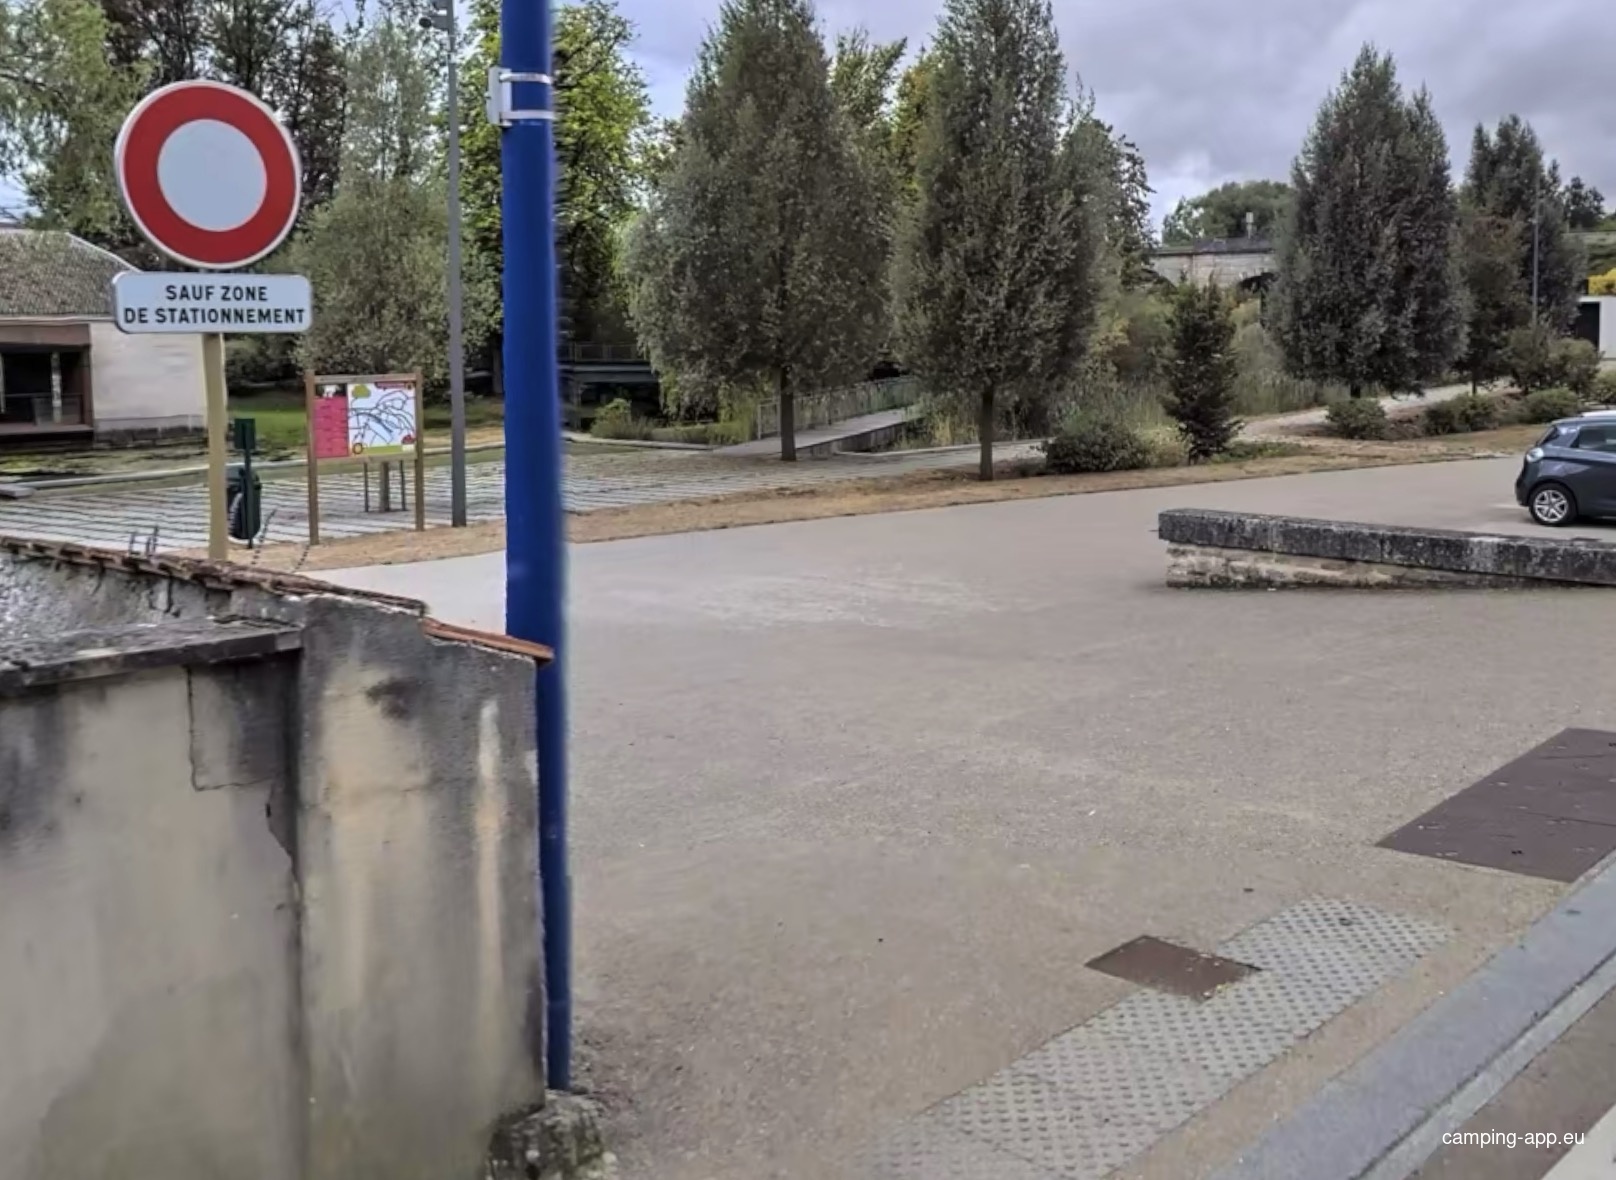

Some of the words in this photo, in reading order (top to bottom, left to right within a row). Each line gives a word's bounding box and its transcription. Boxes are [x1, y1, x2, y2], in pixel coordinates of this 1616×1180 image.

[166, 285, 215, 301] SAUF
[220, 286, 268, 302] ZONE
[124, 308, 149, 324] DE
[155, 308, 305, 325] STATIONNEMENT
